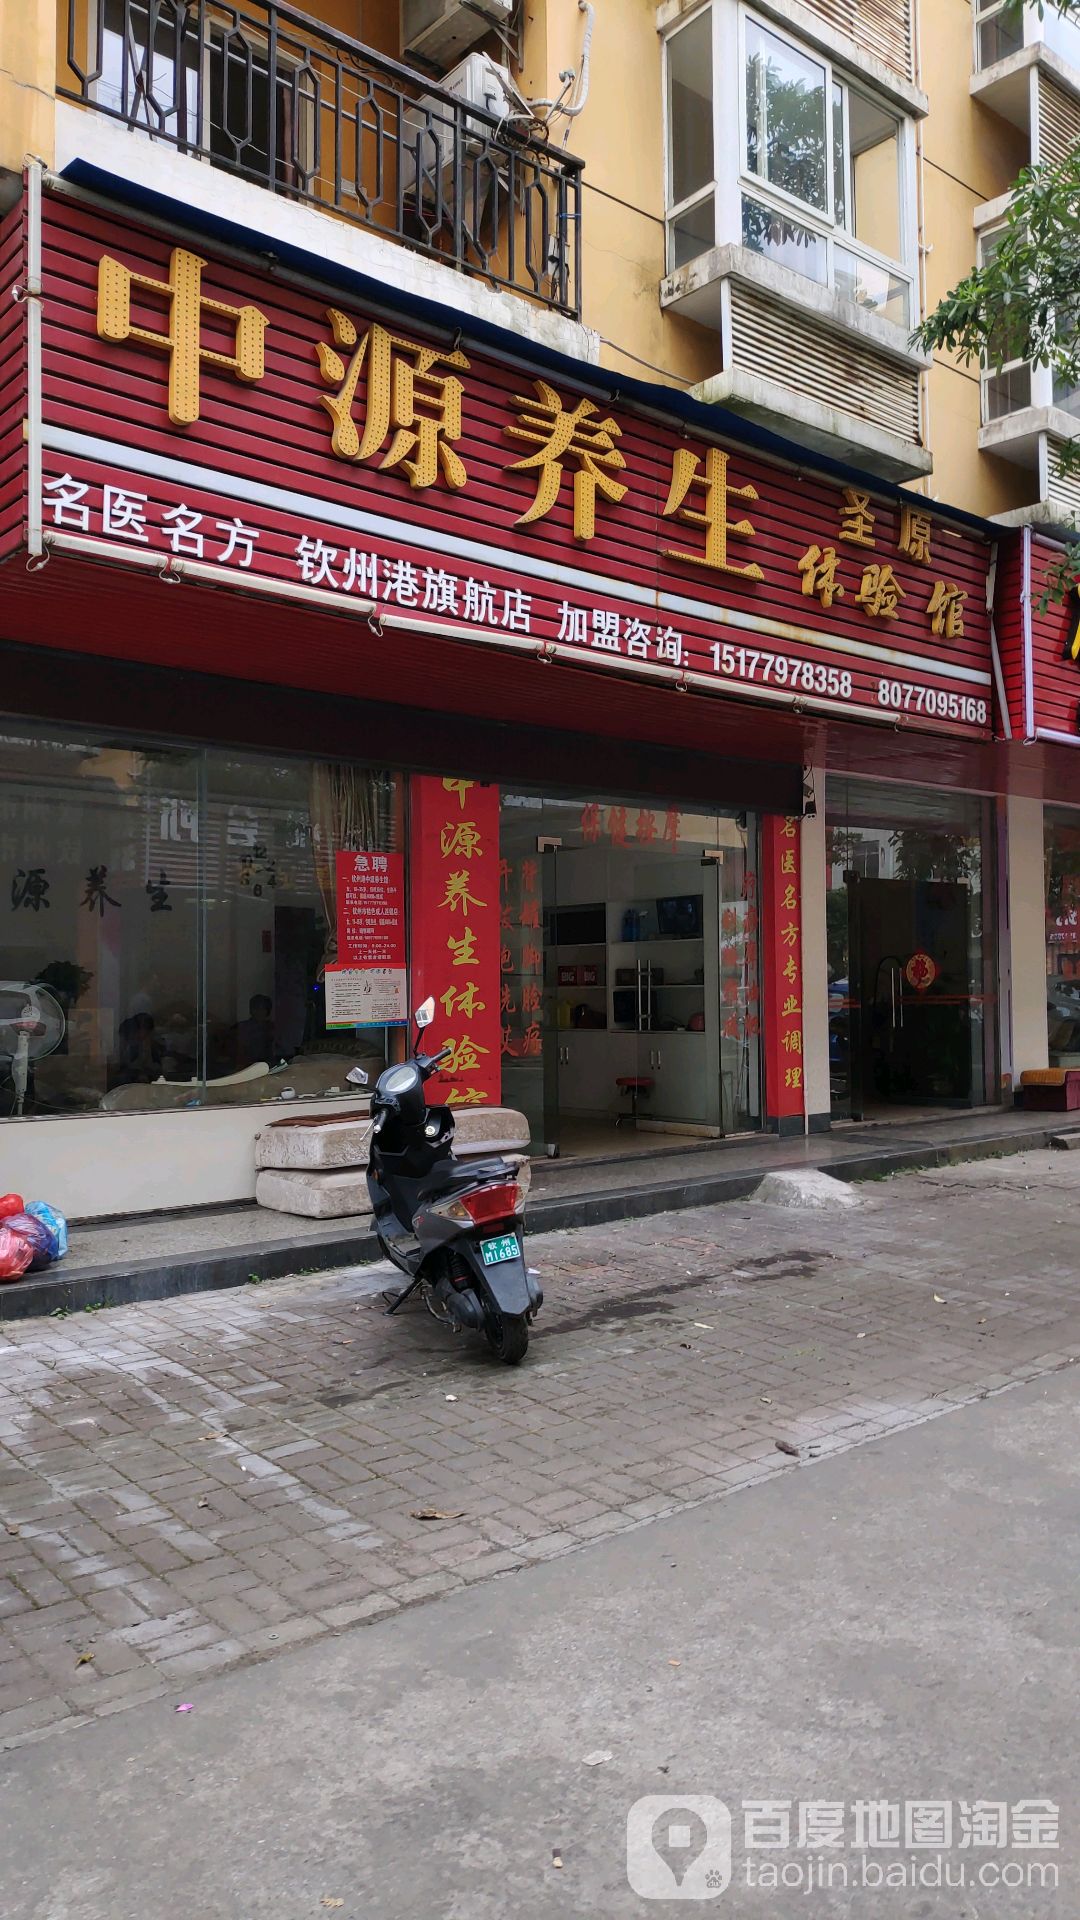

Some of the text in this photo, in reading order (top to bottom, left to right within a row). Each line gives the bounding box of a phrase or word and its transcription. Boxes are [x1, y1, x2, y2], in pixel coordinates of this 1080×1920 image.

[96, 247, 765, 581] 中源养生
[43, 473, 260, 568] 名医名方
[295, 534, 532, 633] 钦州港旗航店
[709, 641, 853, 699] 15177978358
[877, 680, 987, 725] 8077095168
[798, 543, 969, 639] 体验馆
[353, 854, 388, 873] 急聘
[485, 1244, 518, 1263] M1685
